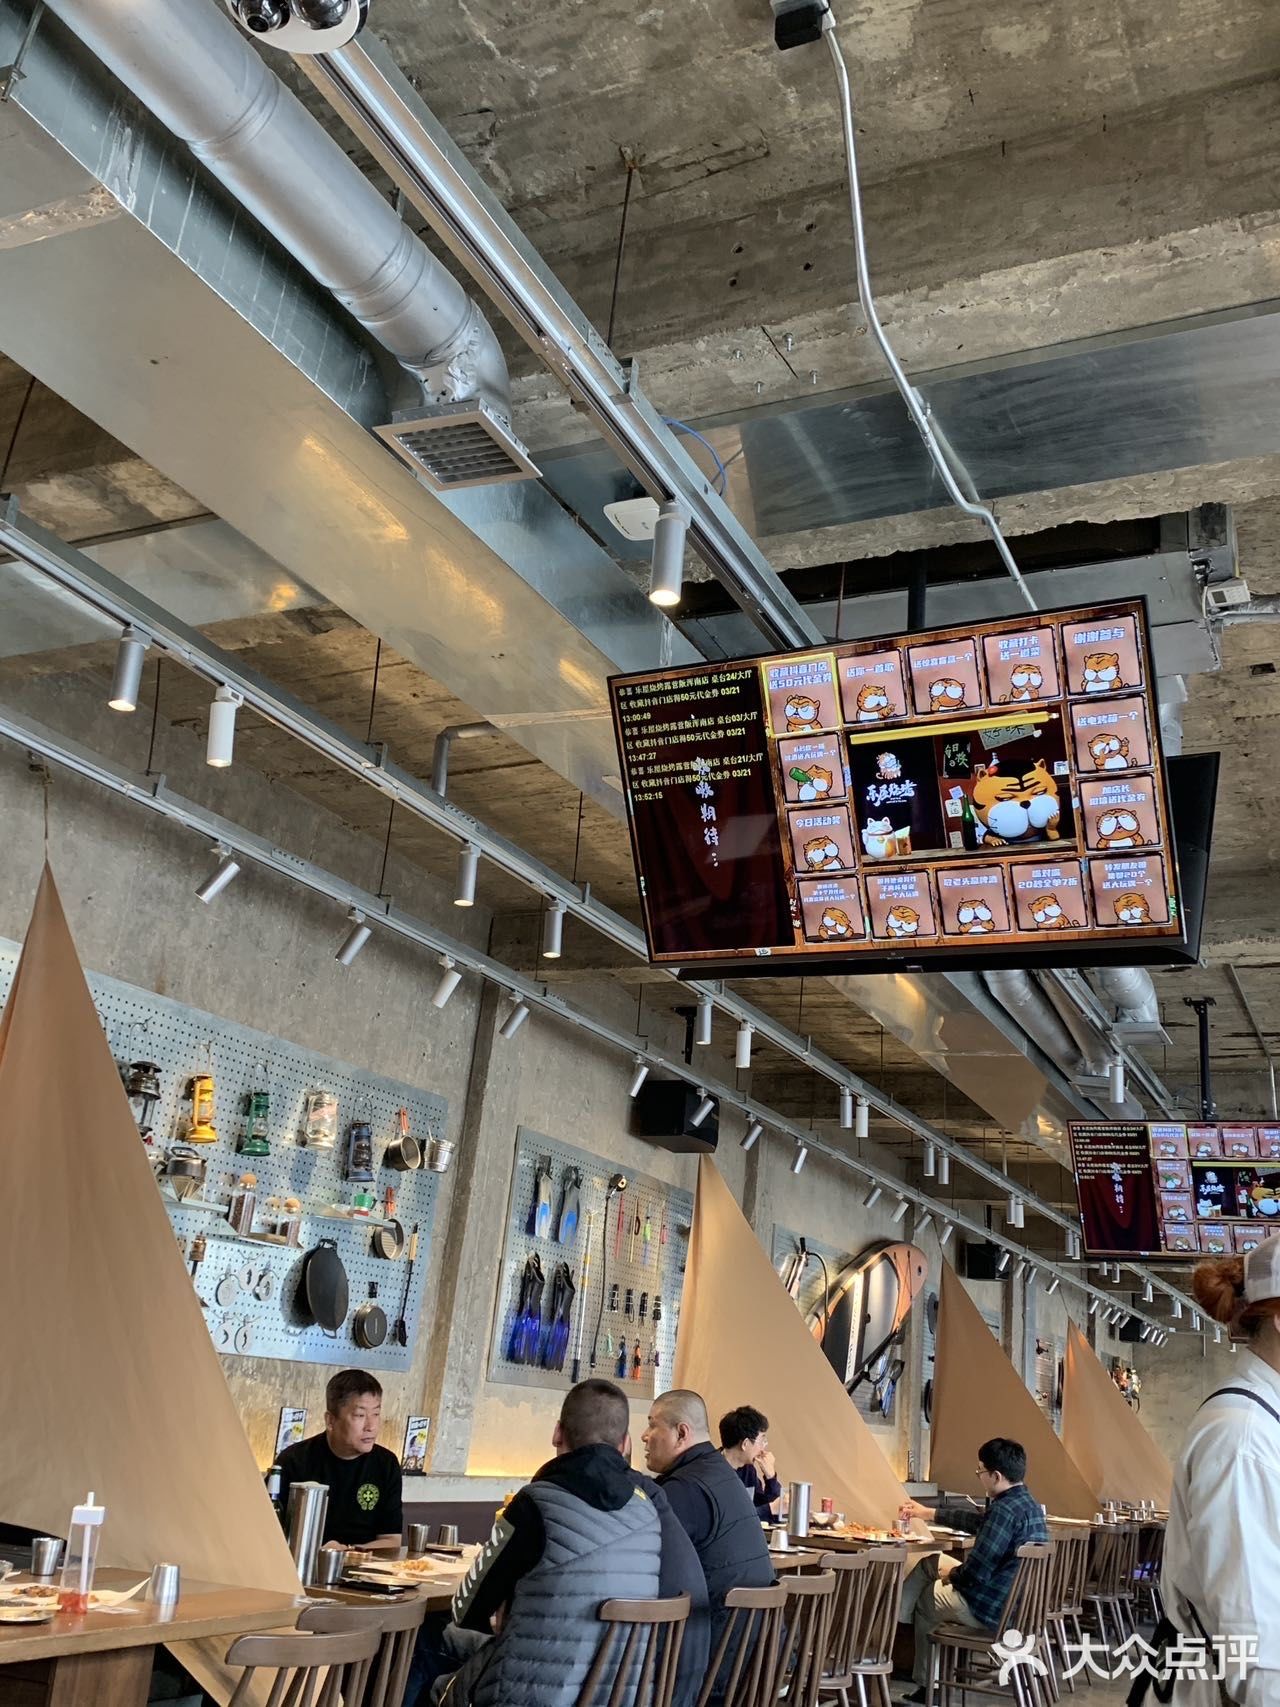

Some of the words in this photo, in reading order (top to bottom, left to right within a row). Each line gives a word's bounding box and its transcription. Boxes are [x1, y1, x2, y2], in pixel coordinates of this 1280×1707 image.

[998, 636, 1039, 649] 收藏打卡
[721, 686, 740, 696] 03/21
[622, 712, 651, 723] 13:00:49
[726, 727, 746, 738] 03/21
[628, 753, 657, 762] 13:47:27
[732, 769, 752, 778] 03/21
[795, 816, 841, 828] 今日活动奖
